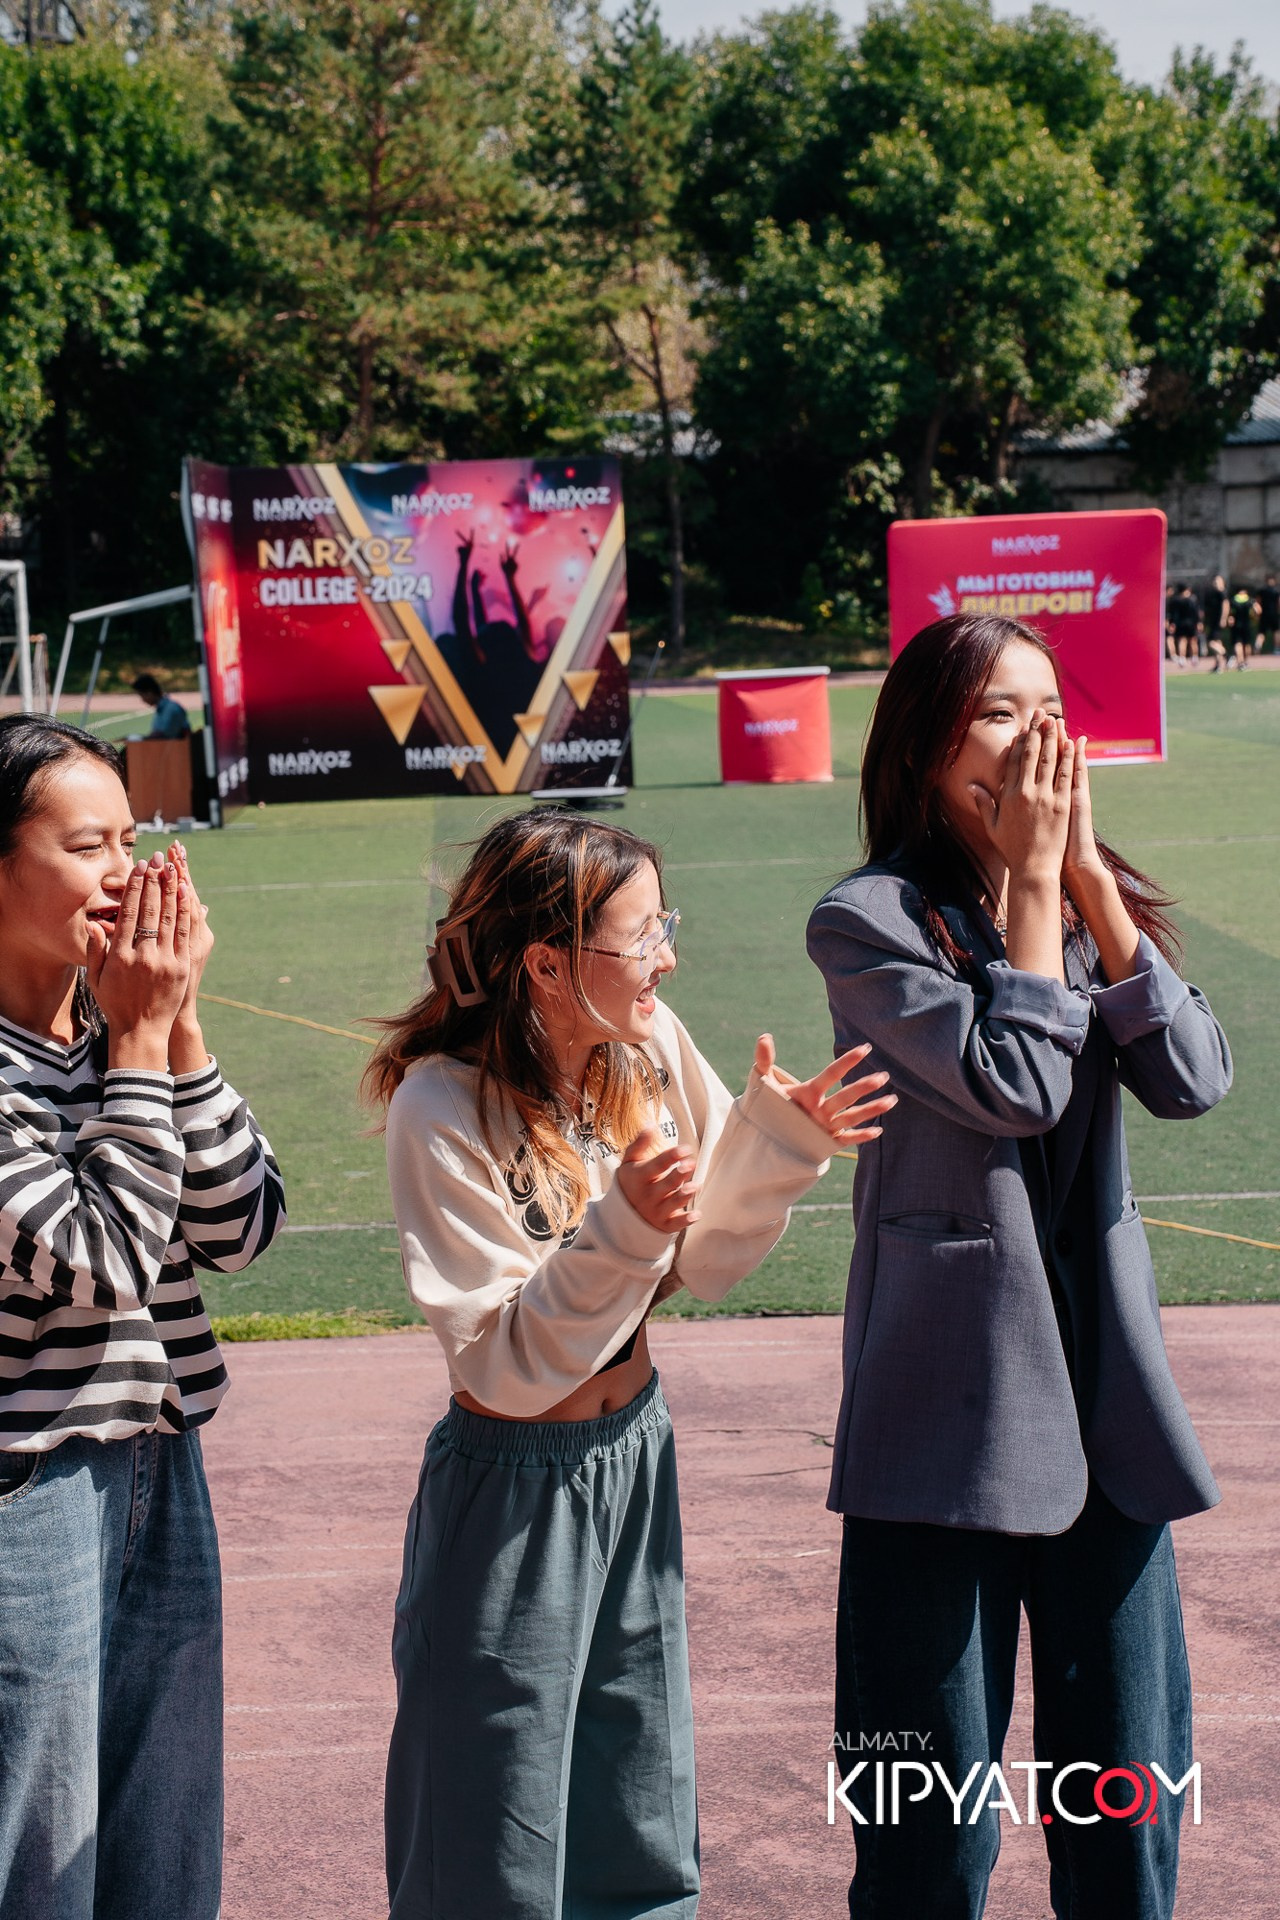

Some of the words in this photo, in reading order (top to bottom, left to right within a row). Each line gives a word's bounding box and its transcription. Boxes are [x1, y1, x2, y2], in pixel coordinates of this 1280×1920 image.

[253, 495, 336, 520] NARXOZ
[391, 492, 474, 516] NARXOZ
[529, 485, 611, 511] NARXOZ
[257, 533, 415, 577] NARXOZ
[260, 577, 358, 606] COLLEGE
[957, 574, 995, 592] МЫ
[996, 570, 1094, 591] ГОТОВИМ
[268, 749, 352, 774] NARXOZ
[405, 744, 487, 768] NARXOZ
[541, 738, 622, 763] NARXOZ
